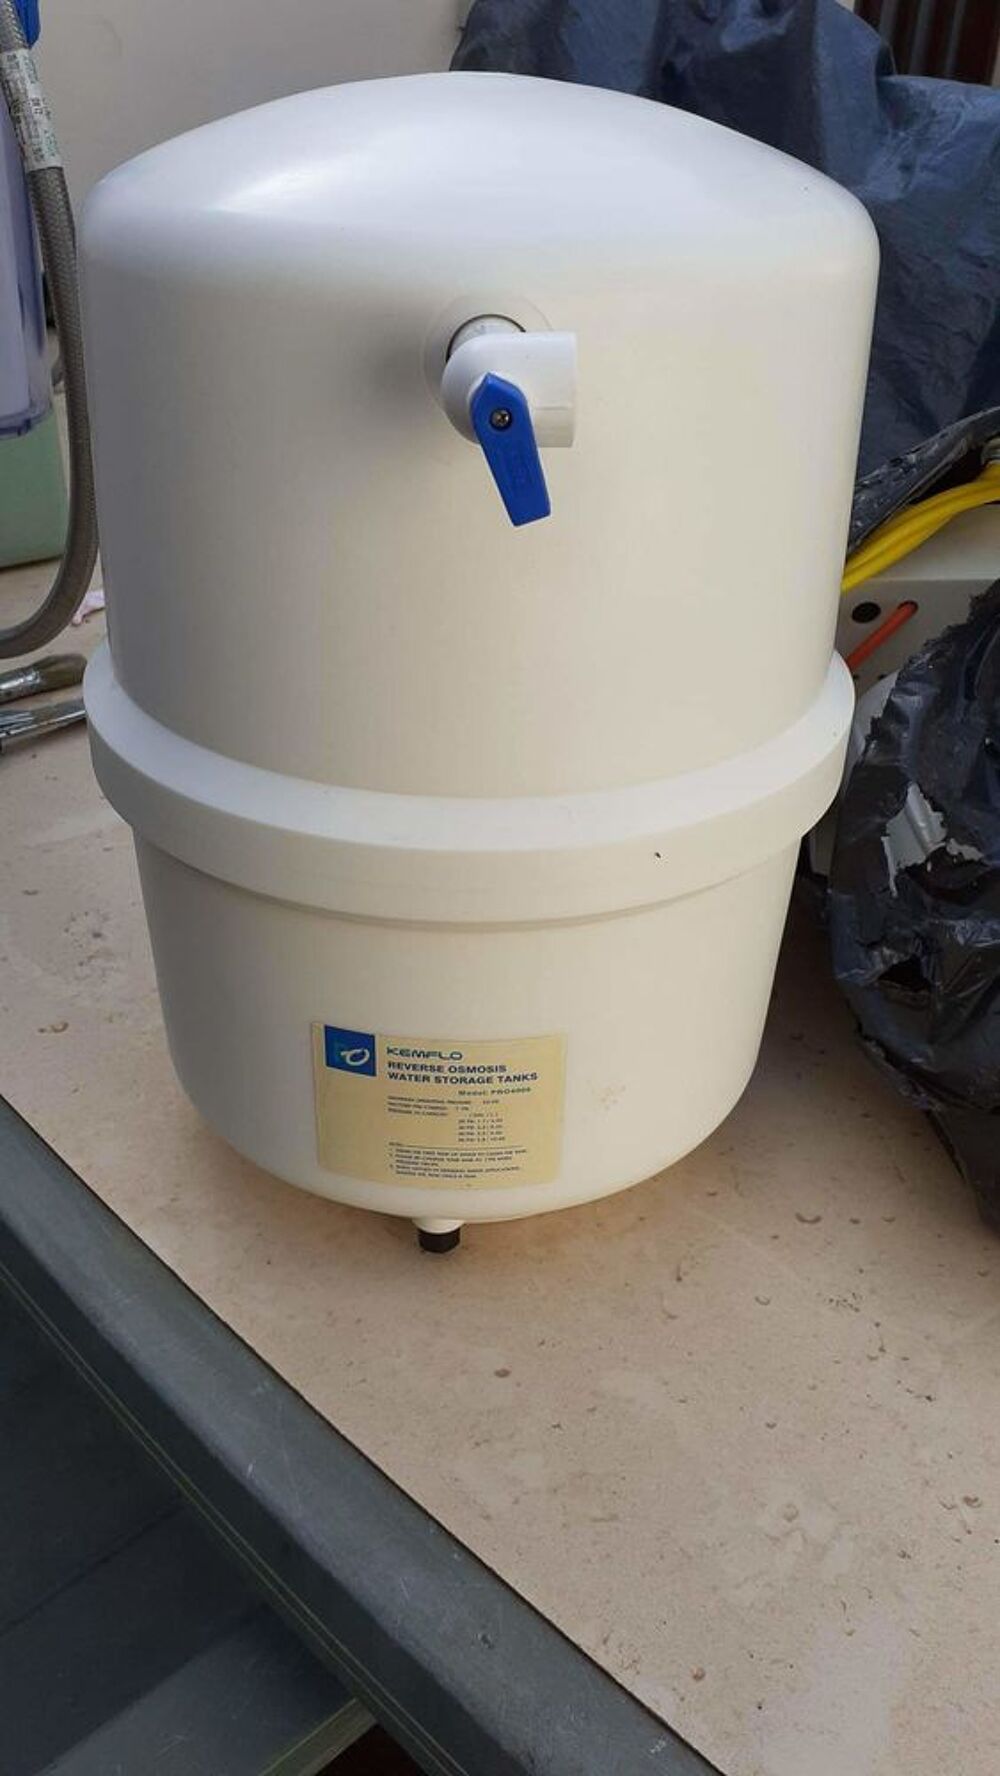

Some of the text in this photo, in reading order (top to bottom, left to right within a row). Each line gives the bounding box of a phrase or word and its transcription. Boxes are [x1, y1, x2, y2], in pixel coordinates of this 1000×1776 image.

[387, 1046, 463, 1061] KEMFLO
[388, 1061, 507, 1074] REVERSE OSMOSIS
[388, 1072, 538, 1084] WATER STORAGE TANKS
